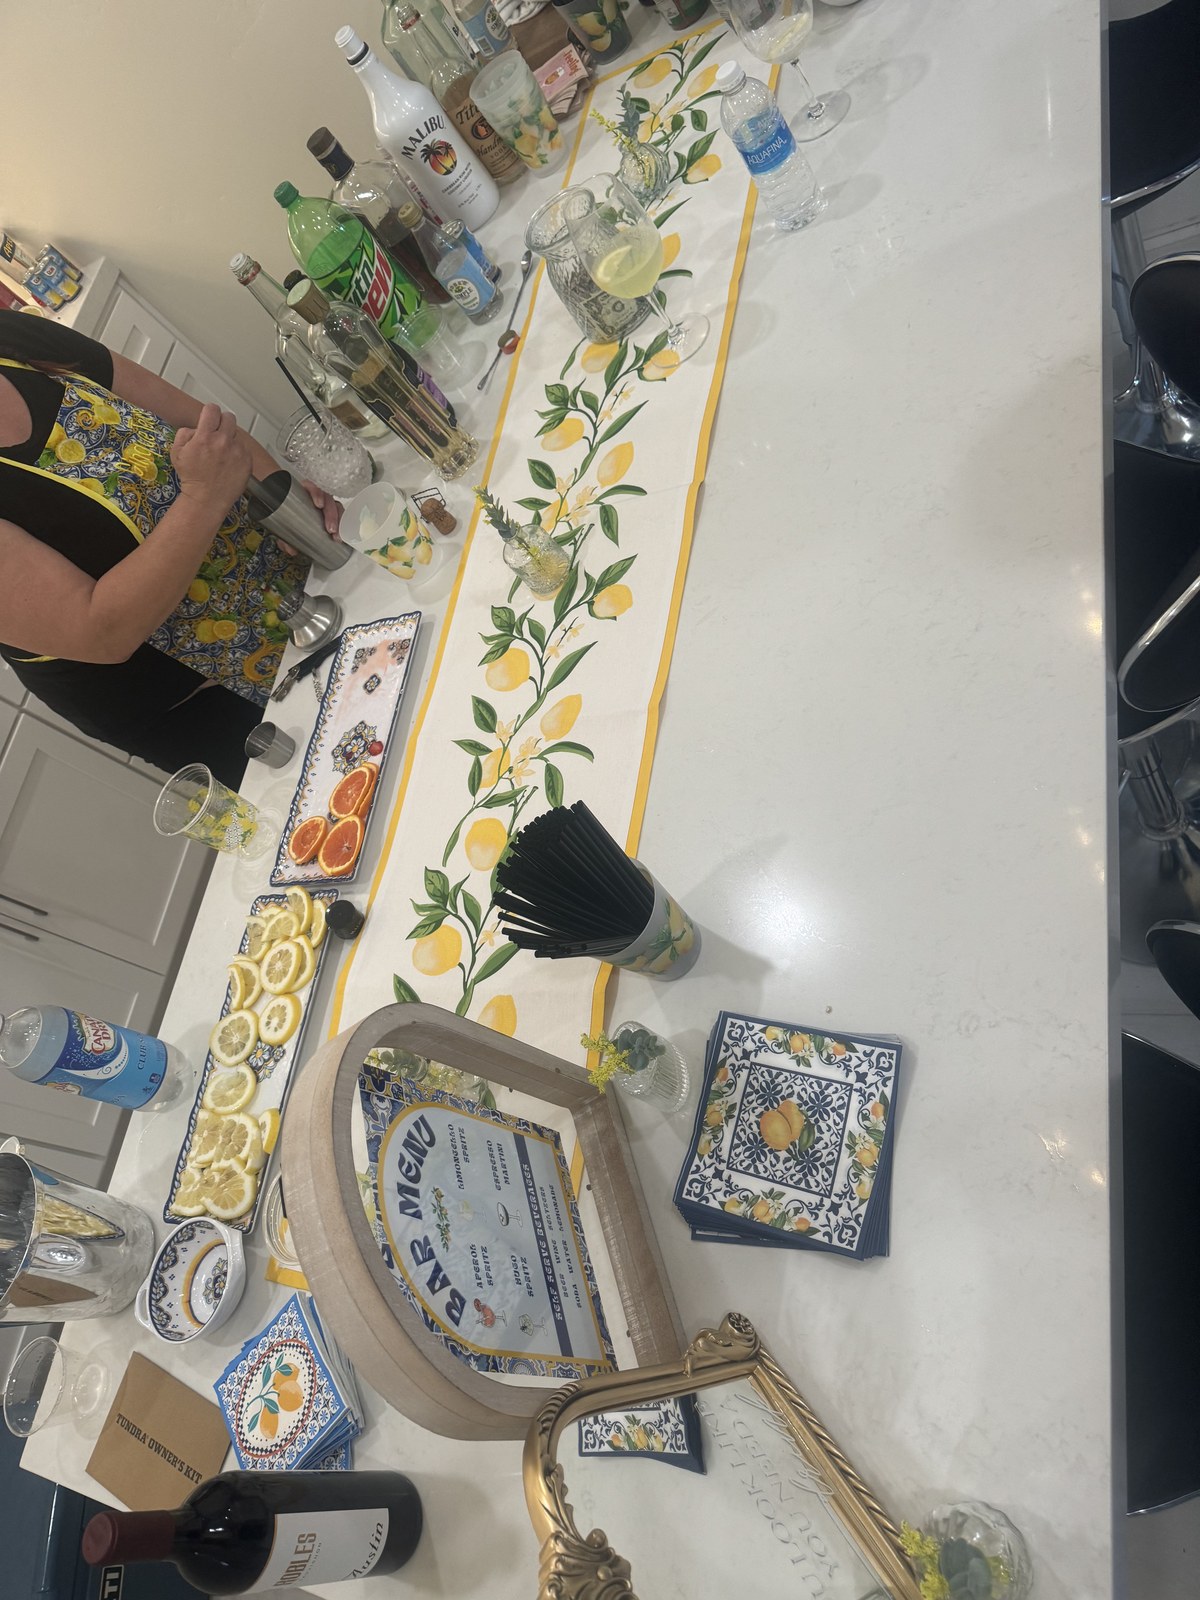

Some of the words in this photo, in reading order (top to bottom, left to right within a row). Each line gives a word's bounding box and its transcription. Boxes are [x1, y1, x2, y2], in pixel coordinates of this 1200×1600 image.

[401, 114, 445, 161] MALIBU
[746, 136, 785, 165] AQUAFINA
[137, 1044, 147, 1070] CLUB
[448, 1124, 464, 1189] LIMONCELLO
[458, 1127, 470, 1163] SPRITZ
[487, 1140, 501, 1191] ESPRESSO
[497, 1143, 510, 1185] MARTINI
[396, 1114, 436, 1220] MENU
[522, 1163, 544, 1236] BEVERAGES
[539, 1186, 553, 1231] SELTZERS
[548, 1184, 564, 1232] LEMONADE
[470, 1244, 483, 1289] APEROL
[481, 1245, 493, 1286] SPRITZ
[511, 1255, 522, 1286] HUGO
[539, 1240, 554, 1282] SERVE
[552, 1239, 561, 1264] WINE
[562, 1240, 573, 1274] WATER
[410, 1234, 467, 1327] BAR
[520, 1257, 534, 1298] SPRITZ
[559, 1273, 569, 1298] BEER
[572, 1283, 582, 1308] SODA
[549, 1286, 562, 1320] SELF
[148, 1437, 185, 1472] OWNER'S
[184, 1465, 202, 1484] KIT
[273, 1532, 317, 1587] ROBLES
[351, 1522, 384, 1578] Austin
[104, 1572, 119, 1600] TI
